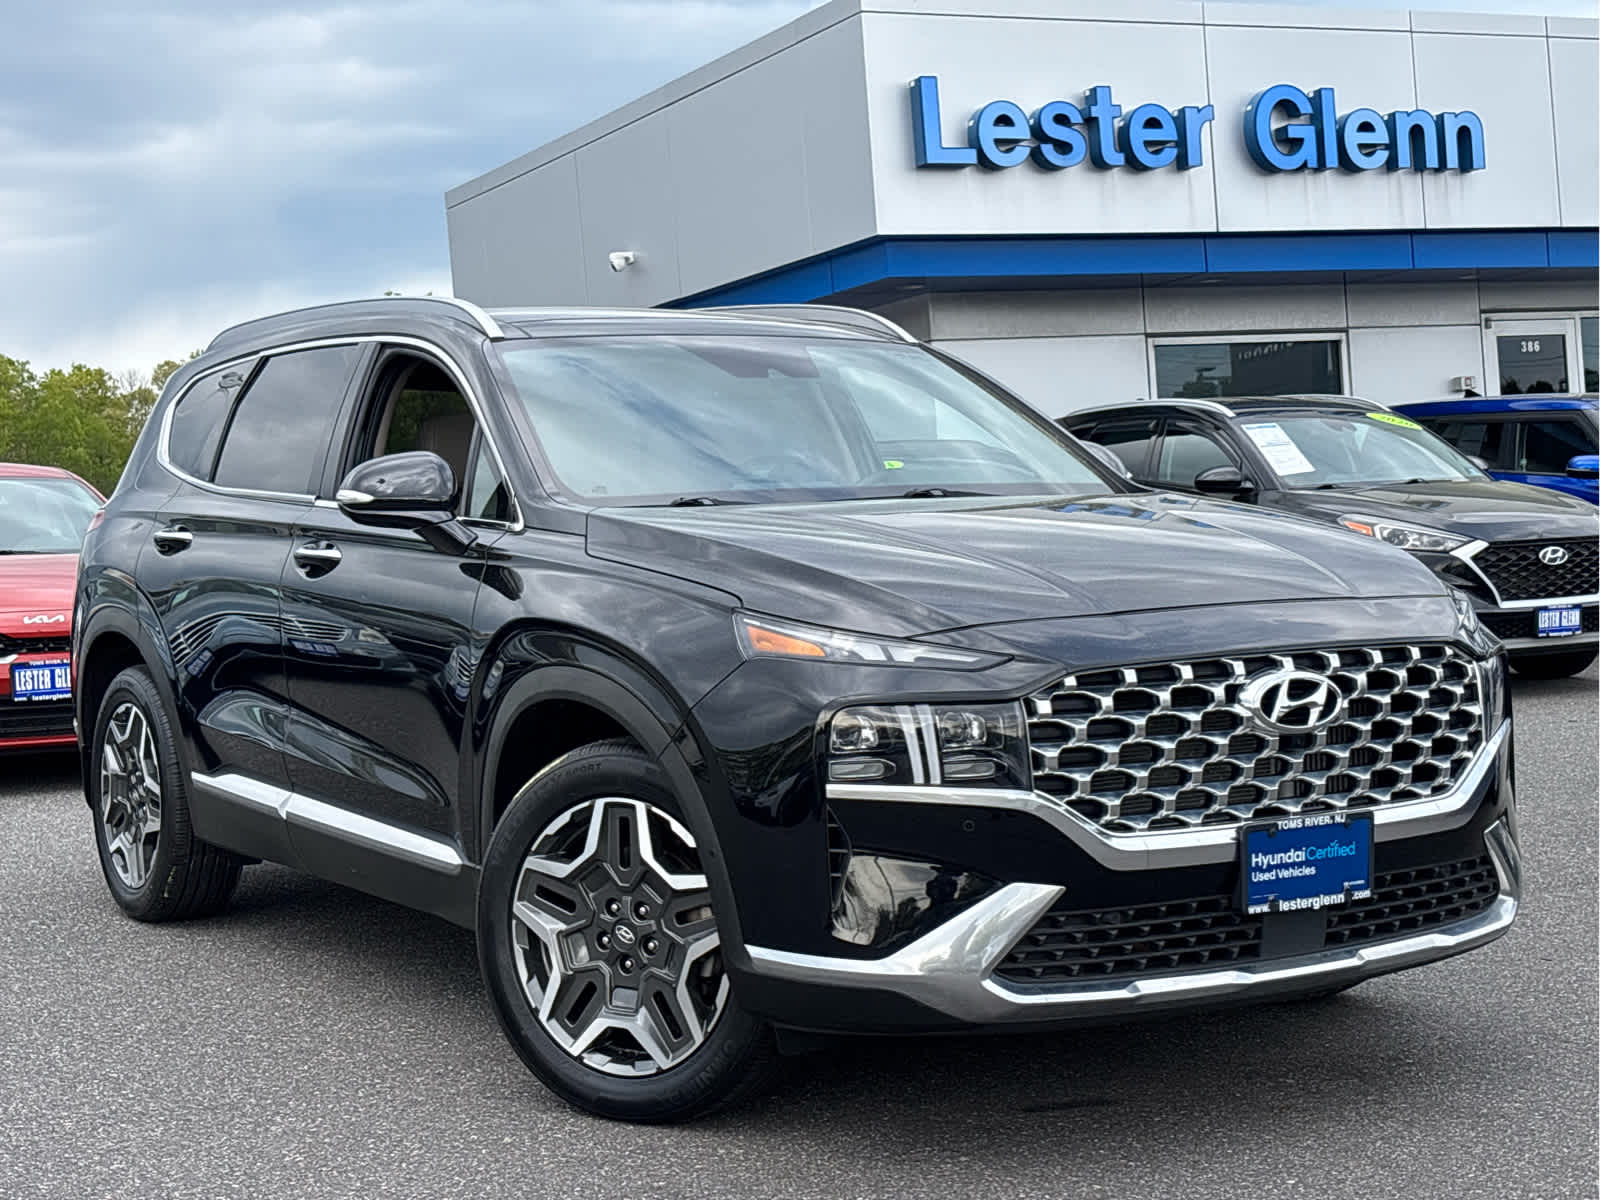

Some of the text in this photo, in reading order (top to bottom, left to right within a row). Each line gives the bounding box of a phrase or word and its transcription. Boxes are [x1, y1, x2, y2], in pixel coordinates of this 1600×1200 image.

[909, 75, 1486, 172] Lester Glenn
[1520, 340, 1540, 352] 386
[15, 669, 51, 691] LESTER
[1277, 818, 1303, 831] TOMS
[1334, 814, 1346, 824] NJ
[1251, 865, 1317, 883] Used Vehicles
[1279, 892, 1345, 912] lesterglenn
